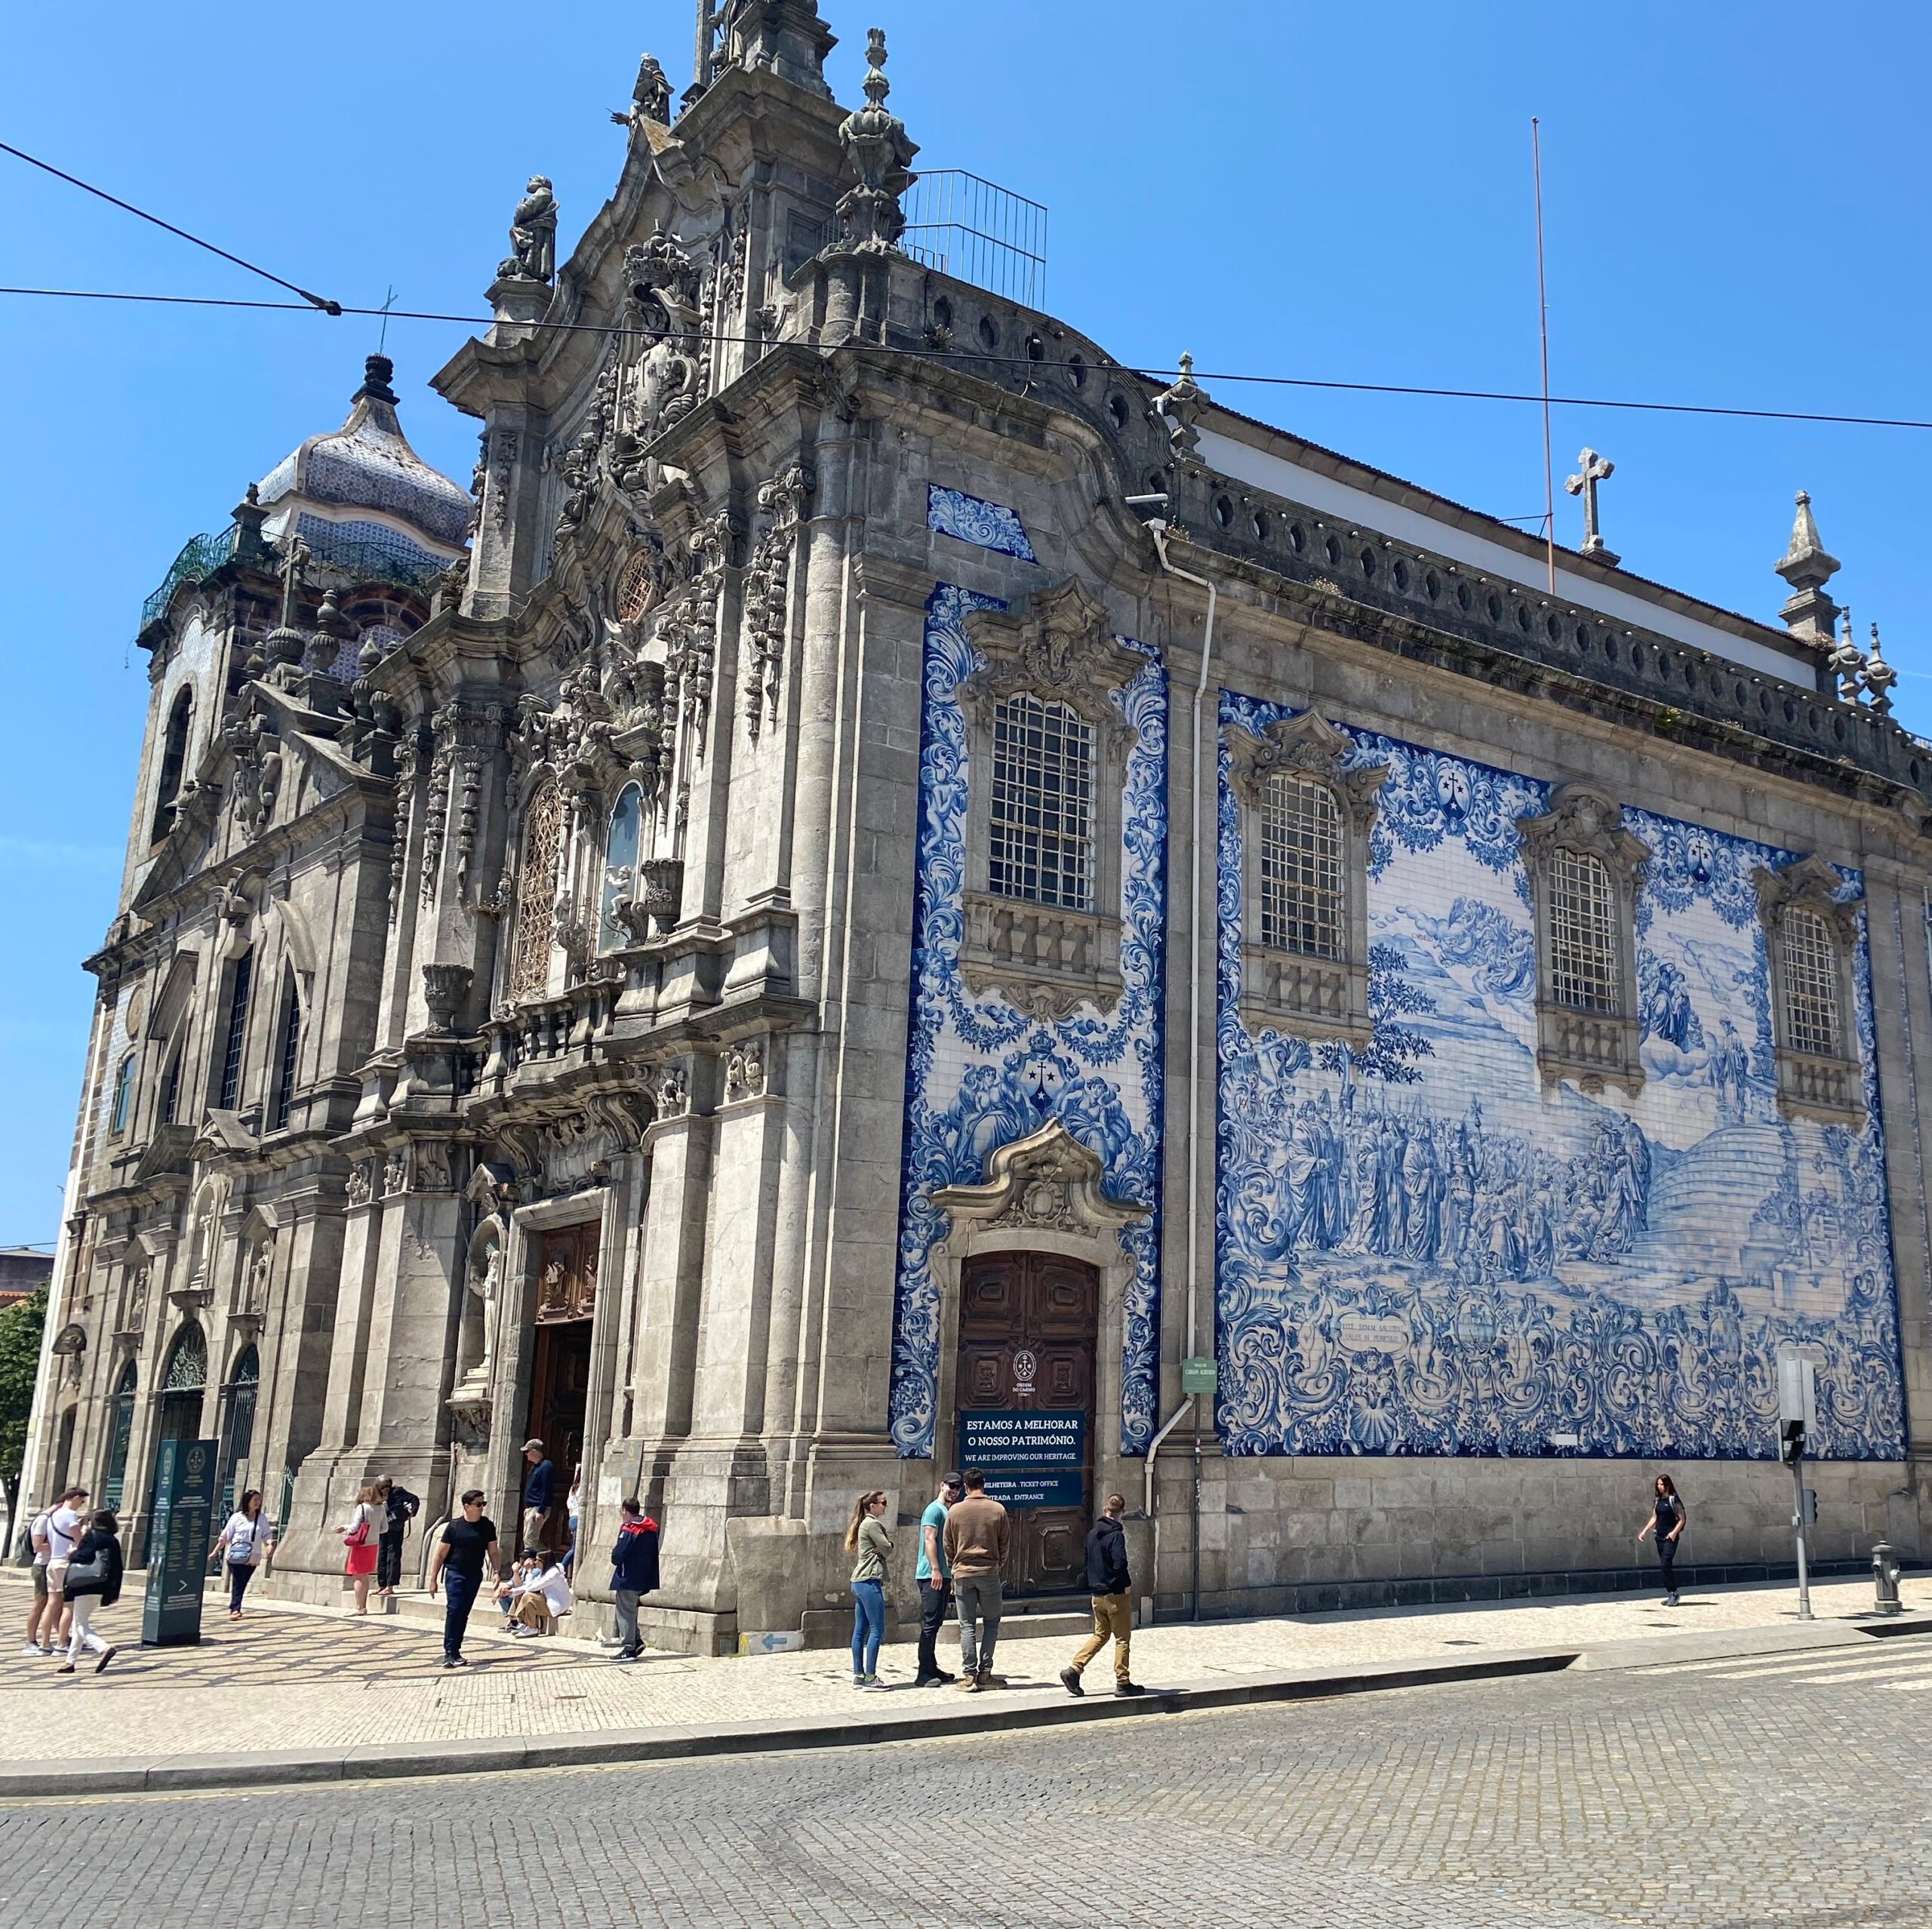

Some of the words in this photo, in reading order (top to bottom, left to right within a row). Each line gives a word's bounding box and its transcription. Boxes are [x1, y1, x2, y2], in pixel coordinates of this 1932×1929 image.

[966, 1420, 1014, 1430] ESTAMOS
[1014, 1421, 1022, 1429] A
[1024, 1420, 1078, 1429] MELHORAR
[968, 1437, 976, 1446] O
[977, 1436, 1010, 1446] NOSSO
[1011, 1434, 1076, 1445] PATRIMÓNIO.
